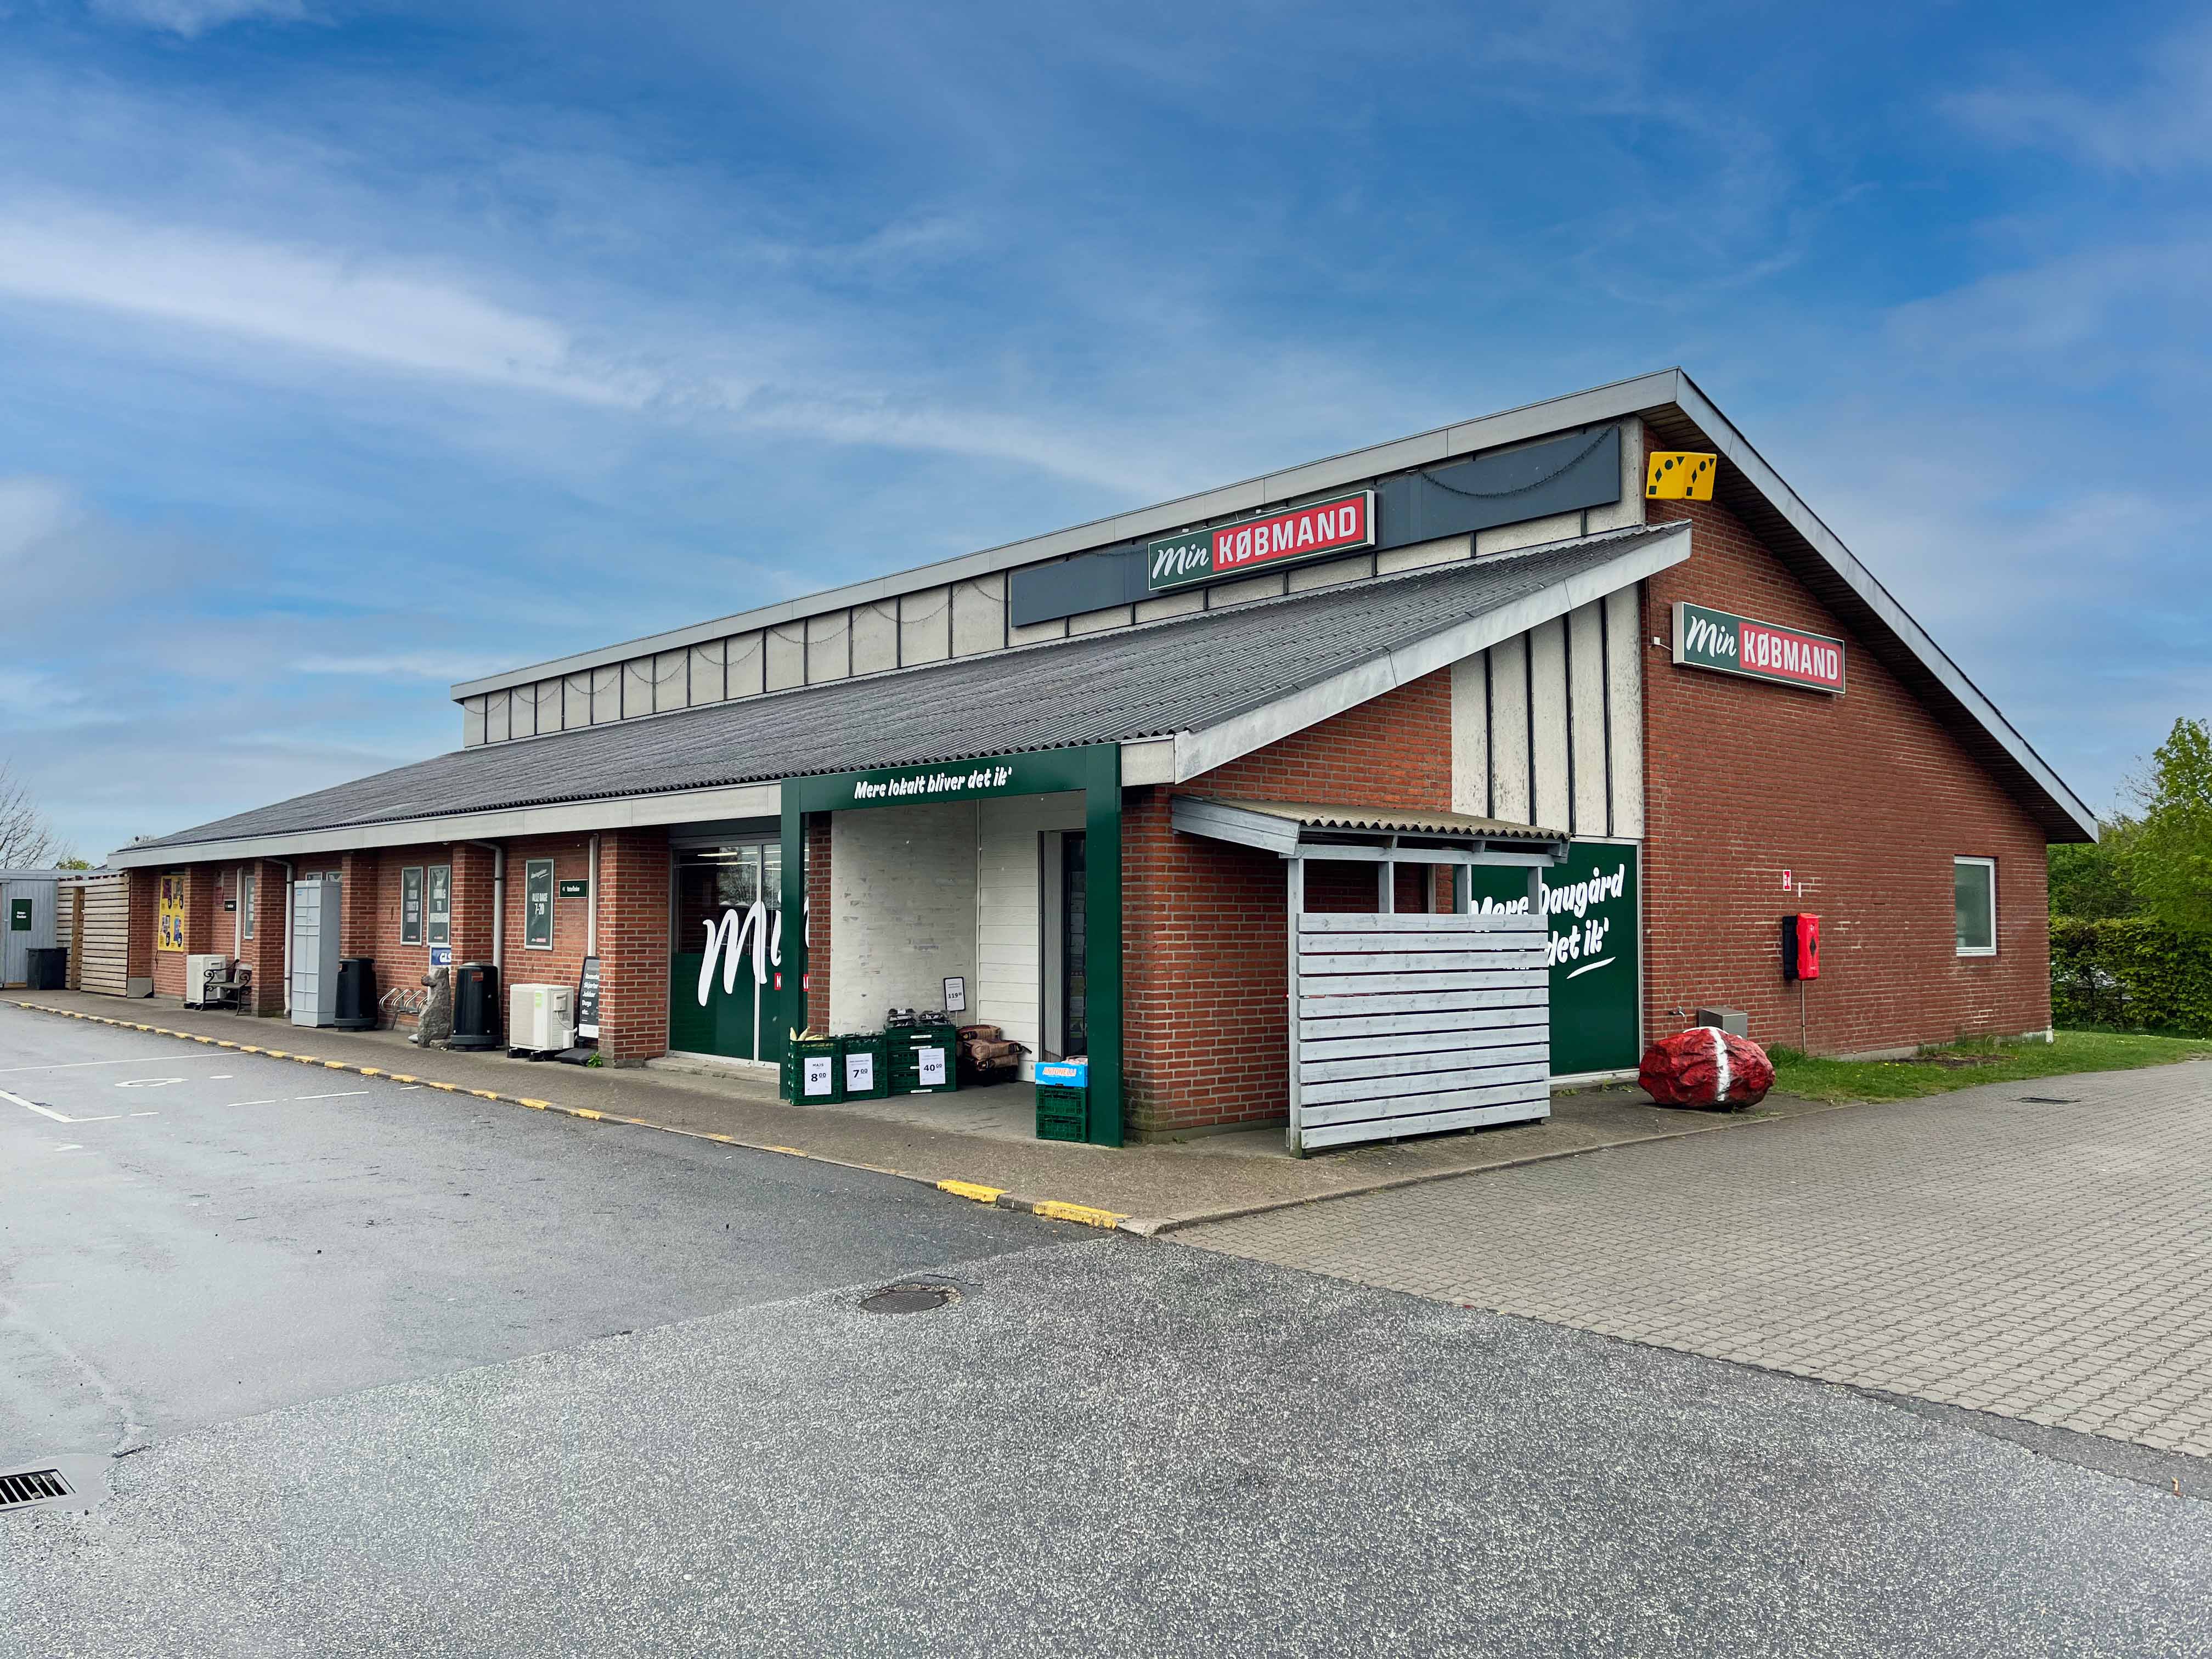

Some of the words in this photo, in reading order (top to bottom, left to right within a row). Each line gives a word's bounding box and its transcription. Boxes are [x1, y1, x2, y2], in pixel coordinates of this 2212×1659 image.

[1152, 544, 1209, 579] Min
[1218, 506, 1357, 565] KØBMAND
[1686, 615, 1737, 658] Min
[1743, 630, 1838, 680] KØBMAND
[854, 780, 887, 799] Mere
[888, 775, 926, 797] lokalt
[927, 772, 966, 793] bliver
[967, 768, 992, 789] det
